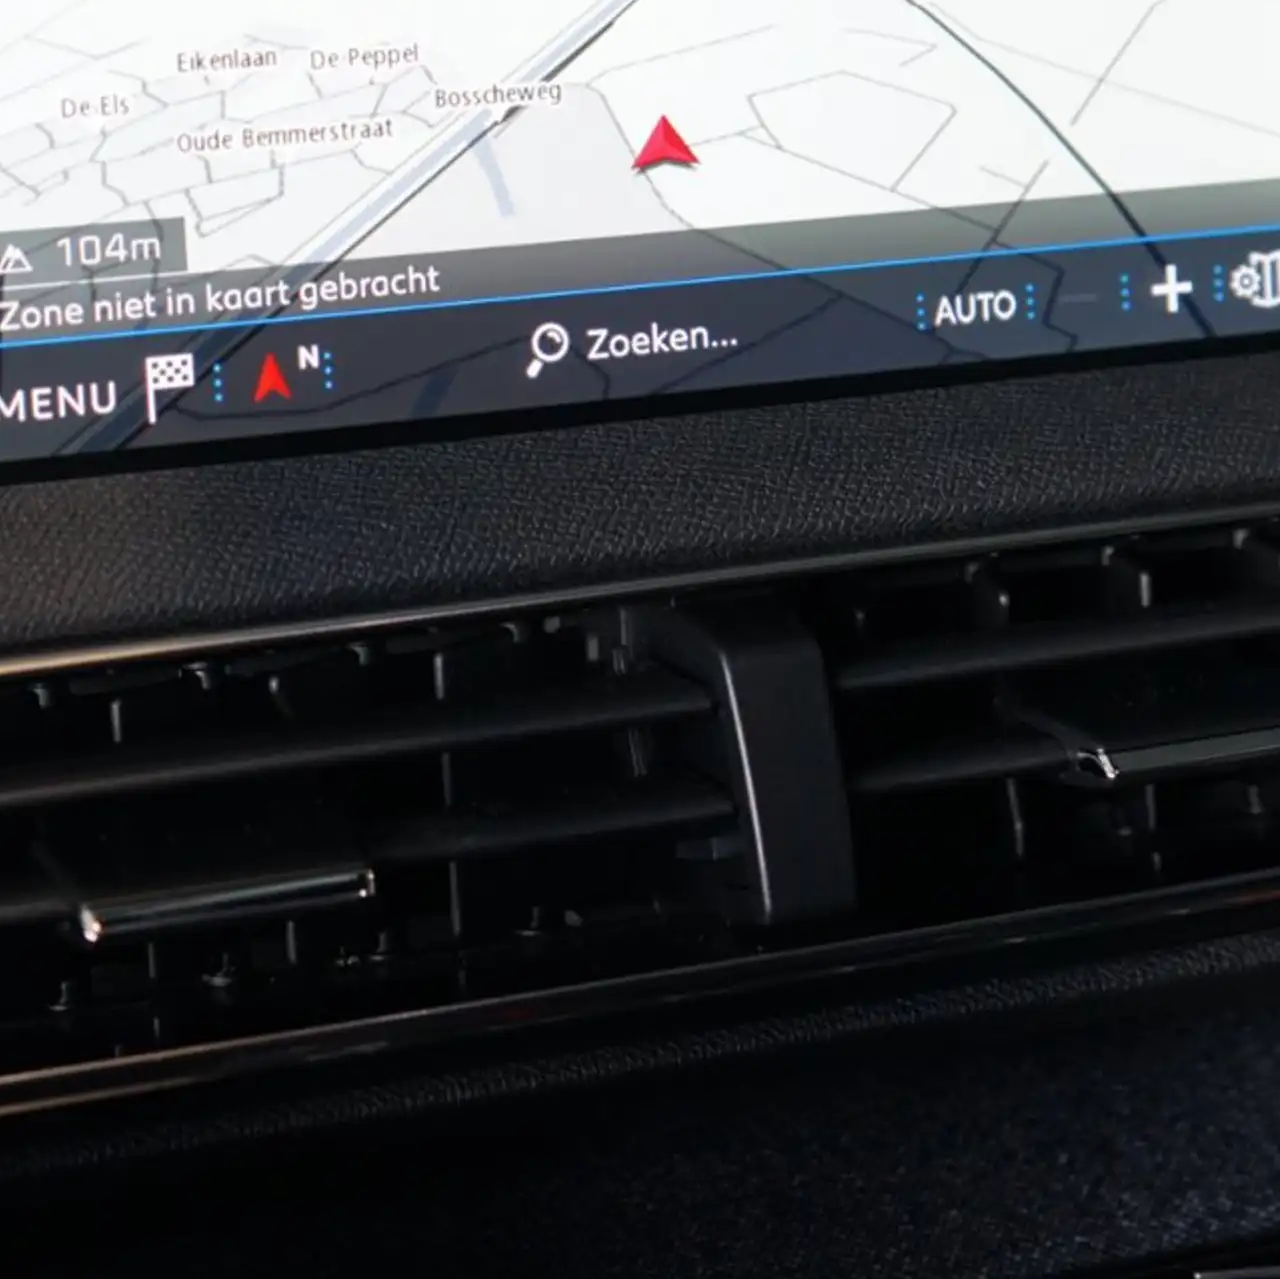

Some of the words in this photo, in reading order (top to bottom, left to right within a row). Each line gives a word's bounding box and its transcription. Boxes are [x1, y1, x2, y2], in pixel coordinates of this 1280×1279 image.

[177, 48, 278, 74] Eikenlaan
[310, 49, 340, 71] De
[348, 42, 420, 71] Peppel
[60, 97, 90, 119] De
[100, 93, 130, 117] Els
[435, 83, 563, 108] Bosscheweg
[176, 128, 233, 153] Oude
[241, 117, 393, 149] Bemmerstraat
[56, 232, 161, 267] 104m
[94, 286, 156, 322] niet
[166, 284, 195, 315] in
[206, 276, 291, 312] kaart
[299, 265, 441, 312] gebracht
[934, 290, 1017, 327] AUTO
[298, 345, 319, 369] N
[586, 323, 738, 360] Zoeken...
